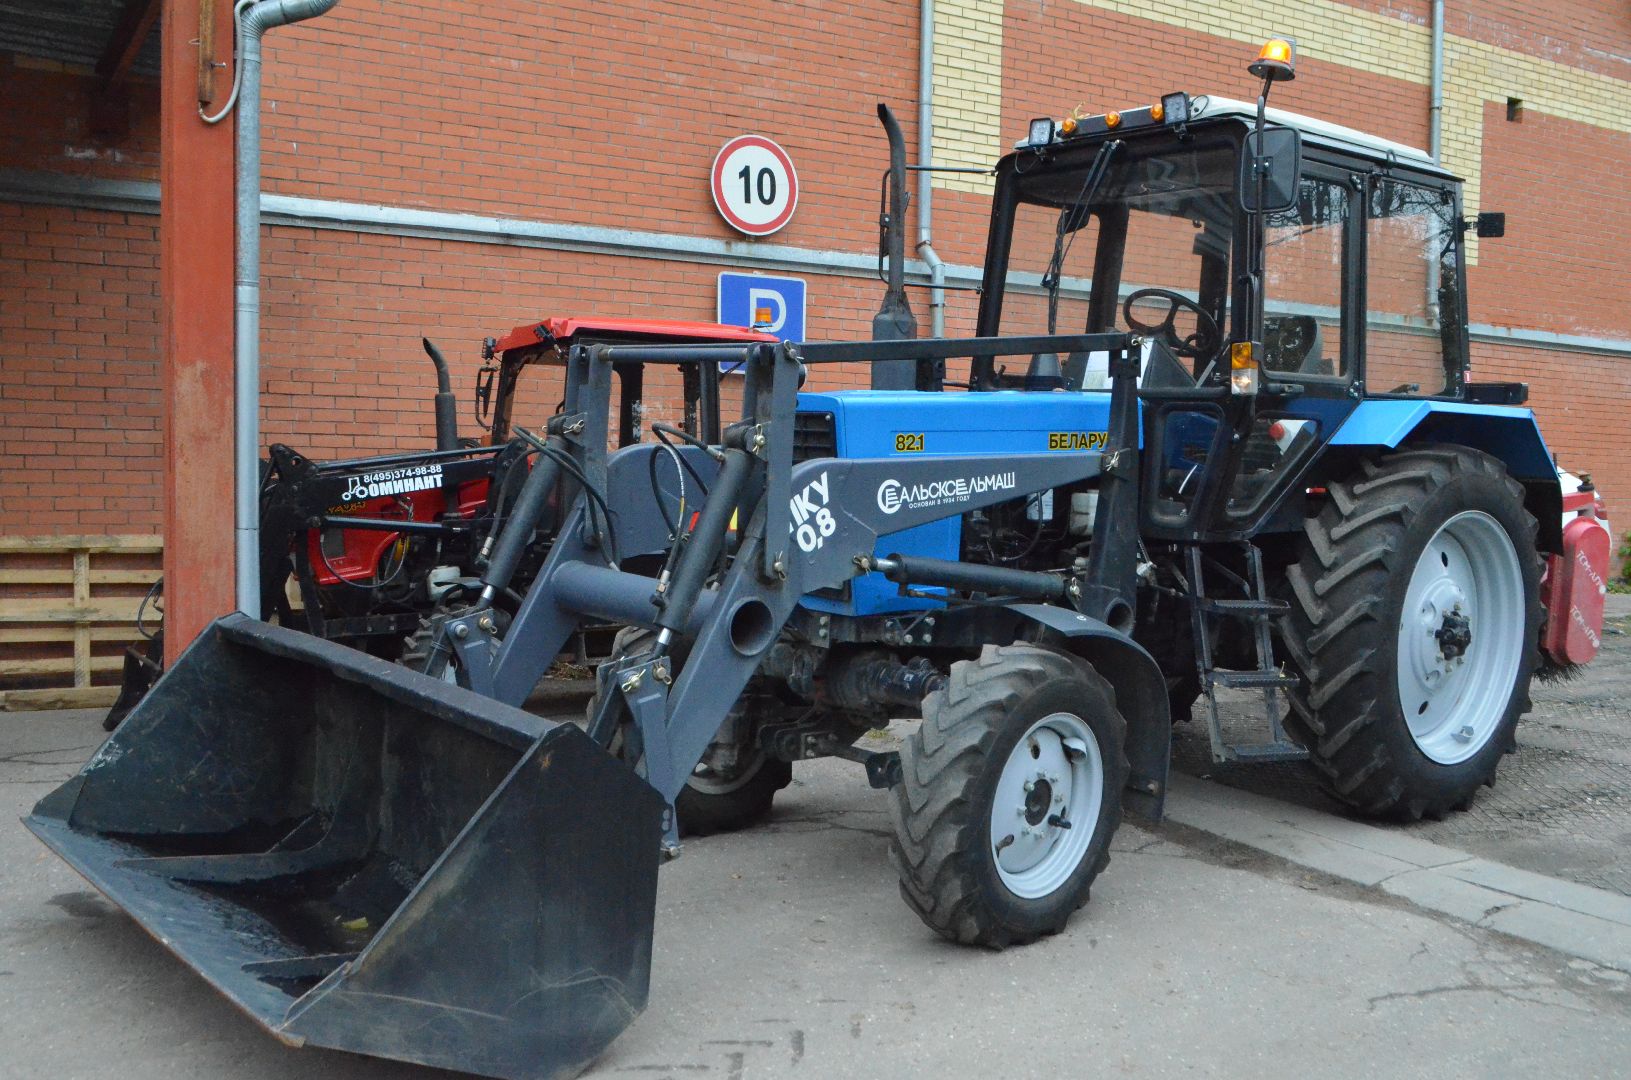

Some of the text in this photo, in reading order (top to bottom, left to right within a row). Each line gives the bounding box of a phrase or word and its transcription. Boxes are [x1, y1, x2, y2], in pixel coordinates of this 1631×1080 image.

[738, 165, 777, 206] 10
[749, 287, 787, 333] P
[895, 433, 924, 451] 82.1
[1049, 432, 1108, 450] БЕЛАРУ
[363, 465, 442, 483] 8(495)374-98-88
[908, 500, 936, 509] ОСНОВАН
[796, 507, 836, 552] 0,8
